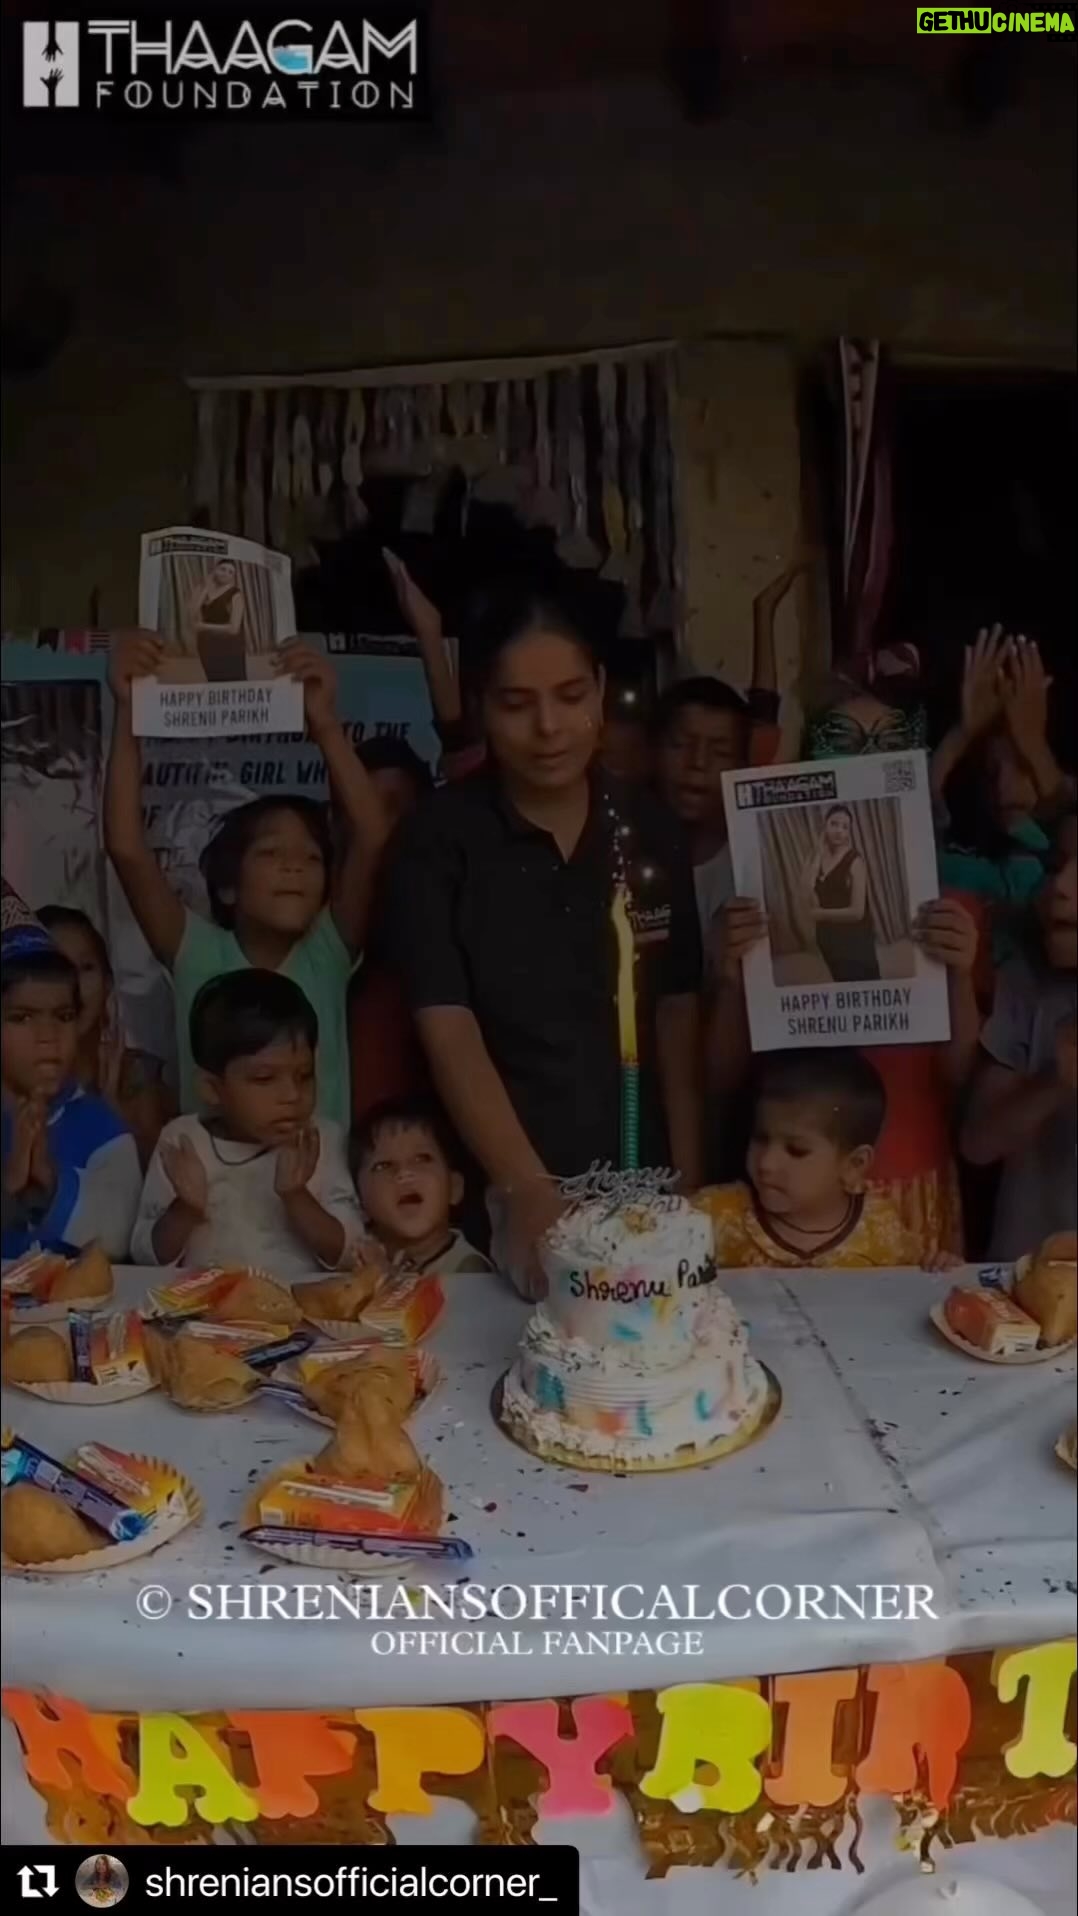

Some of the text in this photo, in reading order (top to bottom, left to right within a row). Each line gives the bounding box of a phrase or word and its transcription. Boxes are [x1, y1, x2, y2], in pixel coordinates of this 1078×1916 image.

[160, 687, 273, 708] HAPPY BIRTHDAY
[164, 708, 269, 727] SHRENU PARIKH
[375, 721, 412, 742] THE
[241, 761, 285, 785] GIRL
[297, 760, 328, 785] WH
[780, 987, 911, 1012] HAPPY BIRTHDAY
[788, 1011, 909, 1036] SHRENU PARIKH
